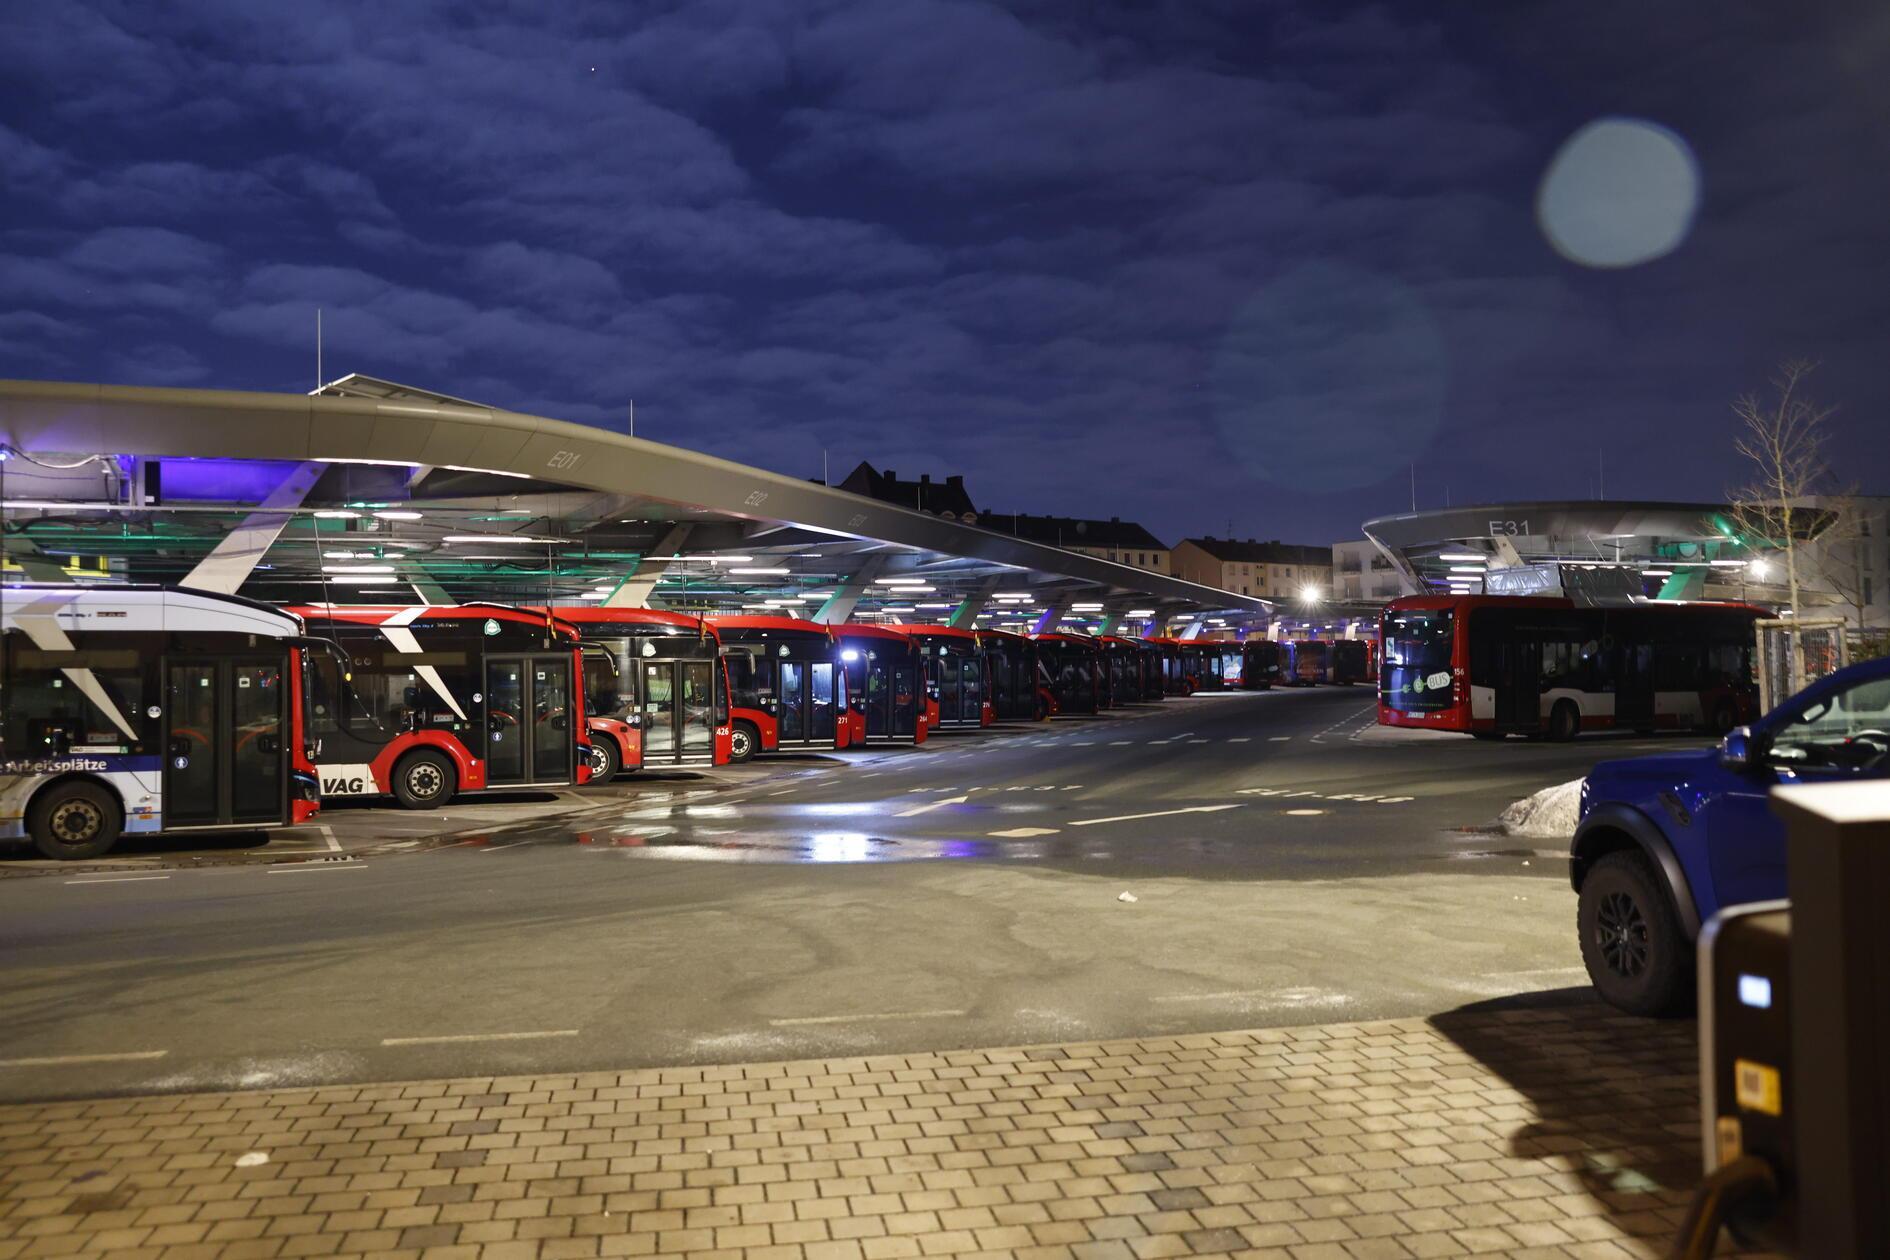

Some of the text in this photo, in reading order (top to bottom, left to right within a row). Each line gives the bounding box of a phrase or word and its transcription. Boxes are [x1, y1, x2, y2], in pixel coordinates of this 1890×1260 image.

[547, 451, 581, 469] E01
[1489, 519, 1529, 536] E31
[1454, 667, 1465, 676] 156
[1429, 673, 1448, 688] BUS
[838, 716, 848, 724] 271
[716, 727, 729, 736] 426
[5, 759, 108, 773] Arbeitsplätze
[323, 778, 363, 794] VAG
